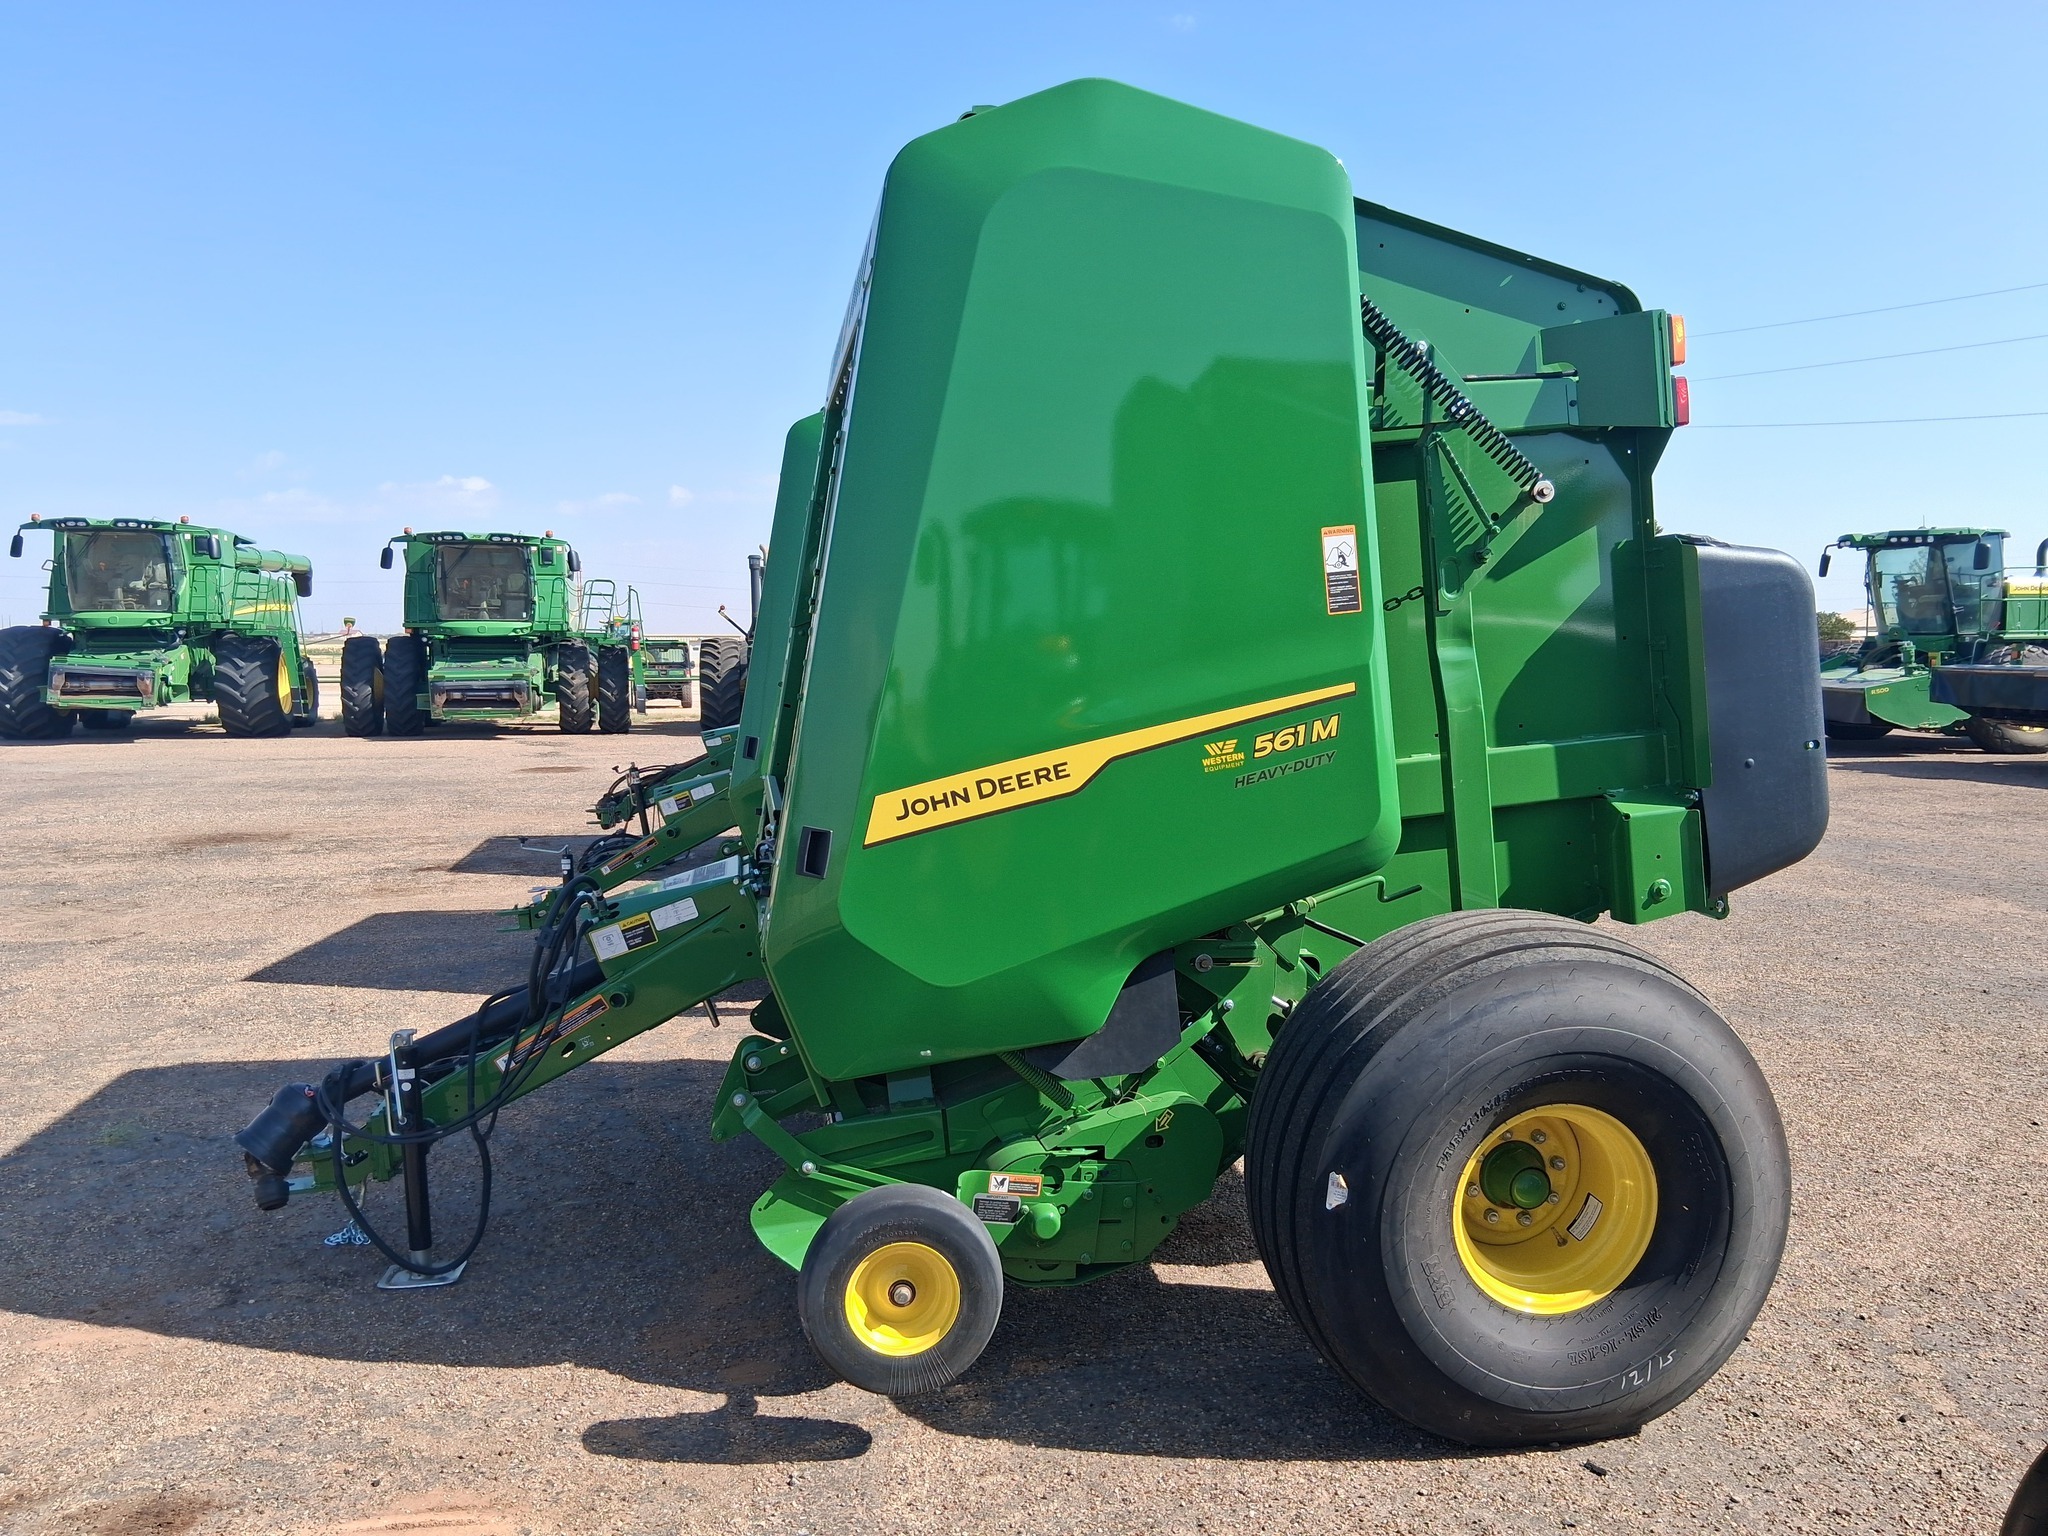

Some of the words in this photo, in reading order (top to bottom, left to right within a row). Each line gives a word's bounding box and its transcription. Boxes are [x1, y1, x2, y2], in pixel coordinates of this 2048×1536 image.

[1202, 752, 1245, 766] WESTERN
[1204, 760, 1245, 773] EQUIPMENT
[1235, 750, 1337, 789] HEAVY-DUTY
[896, 786, 971, 821] JOHN
[975, 761, 1071, 800] DEERE
